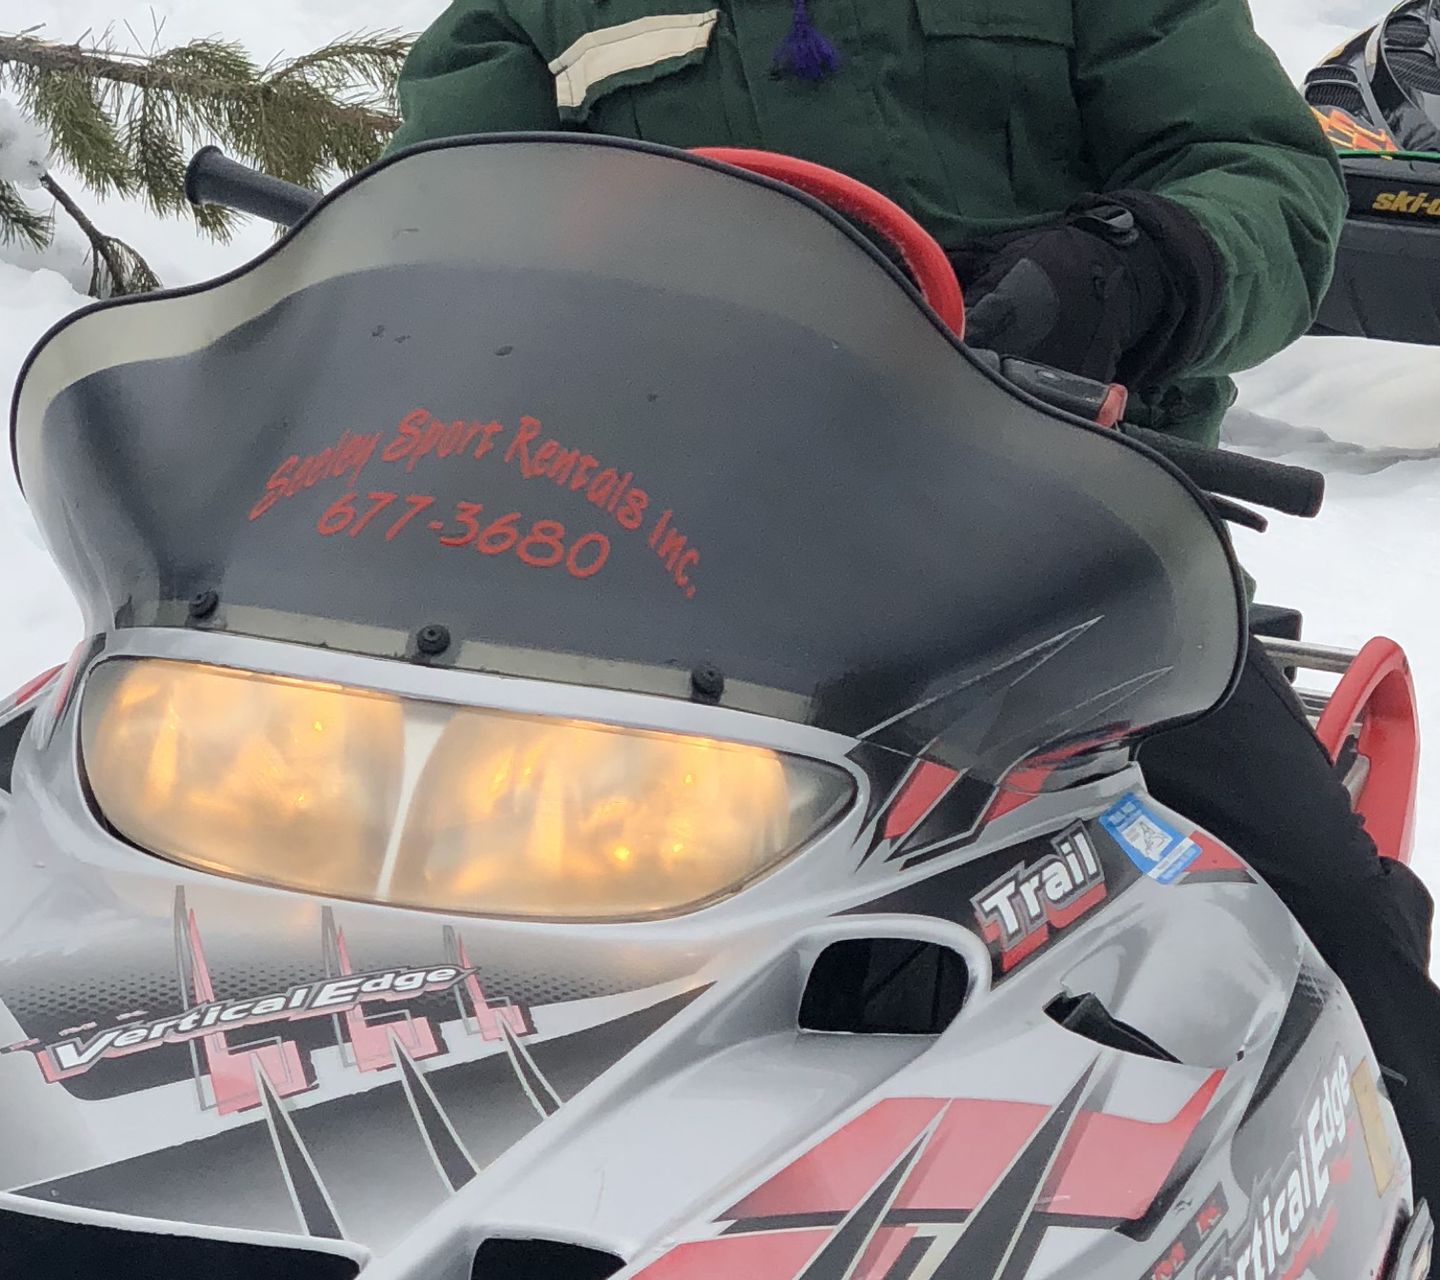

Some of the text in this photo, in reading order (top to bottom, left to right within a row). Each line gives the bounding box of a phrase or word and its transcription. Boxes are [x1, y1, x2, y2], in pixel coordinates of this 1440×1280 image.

[317, 490, 611, 579] 677-3680
[381, 407, 503, 474] Sport
[504, 415, 649, 531] Rentals
[649, 508, 700, 600] Inc.
[981, 831, 1098, 935] Trail
